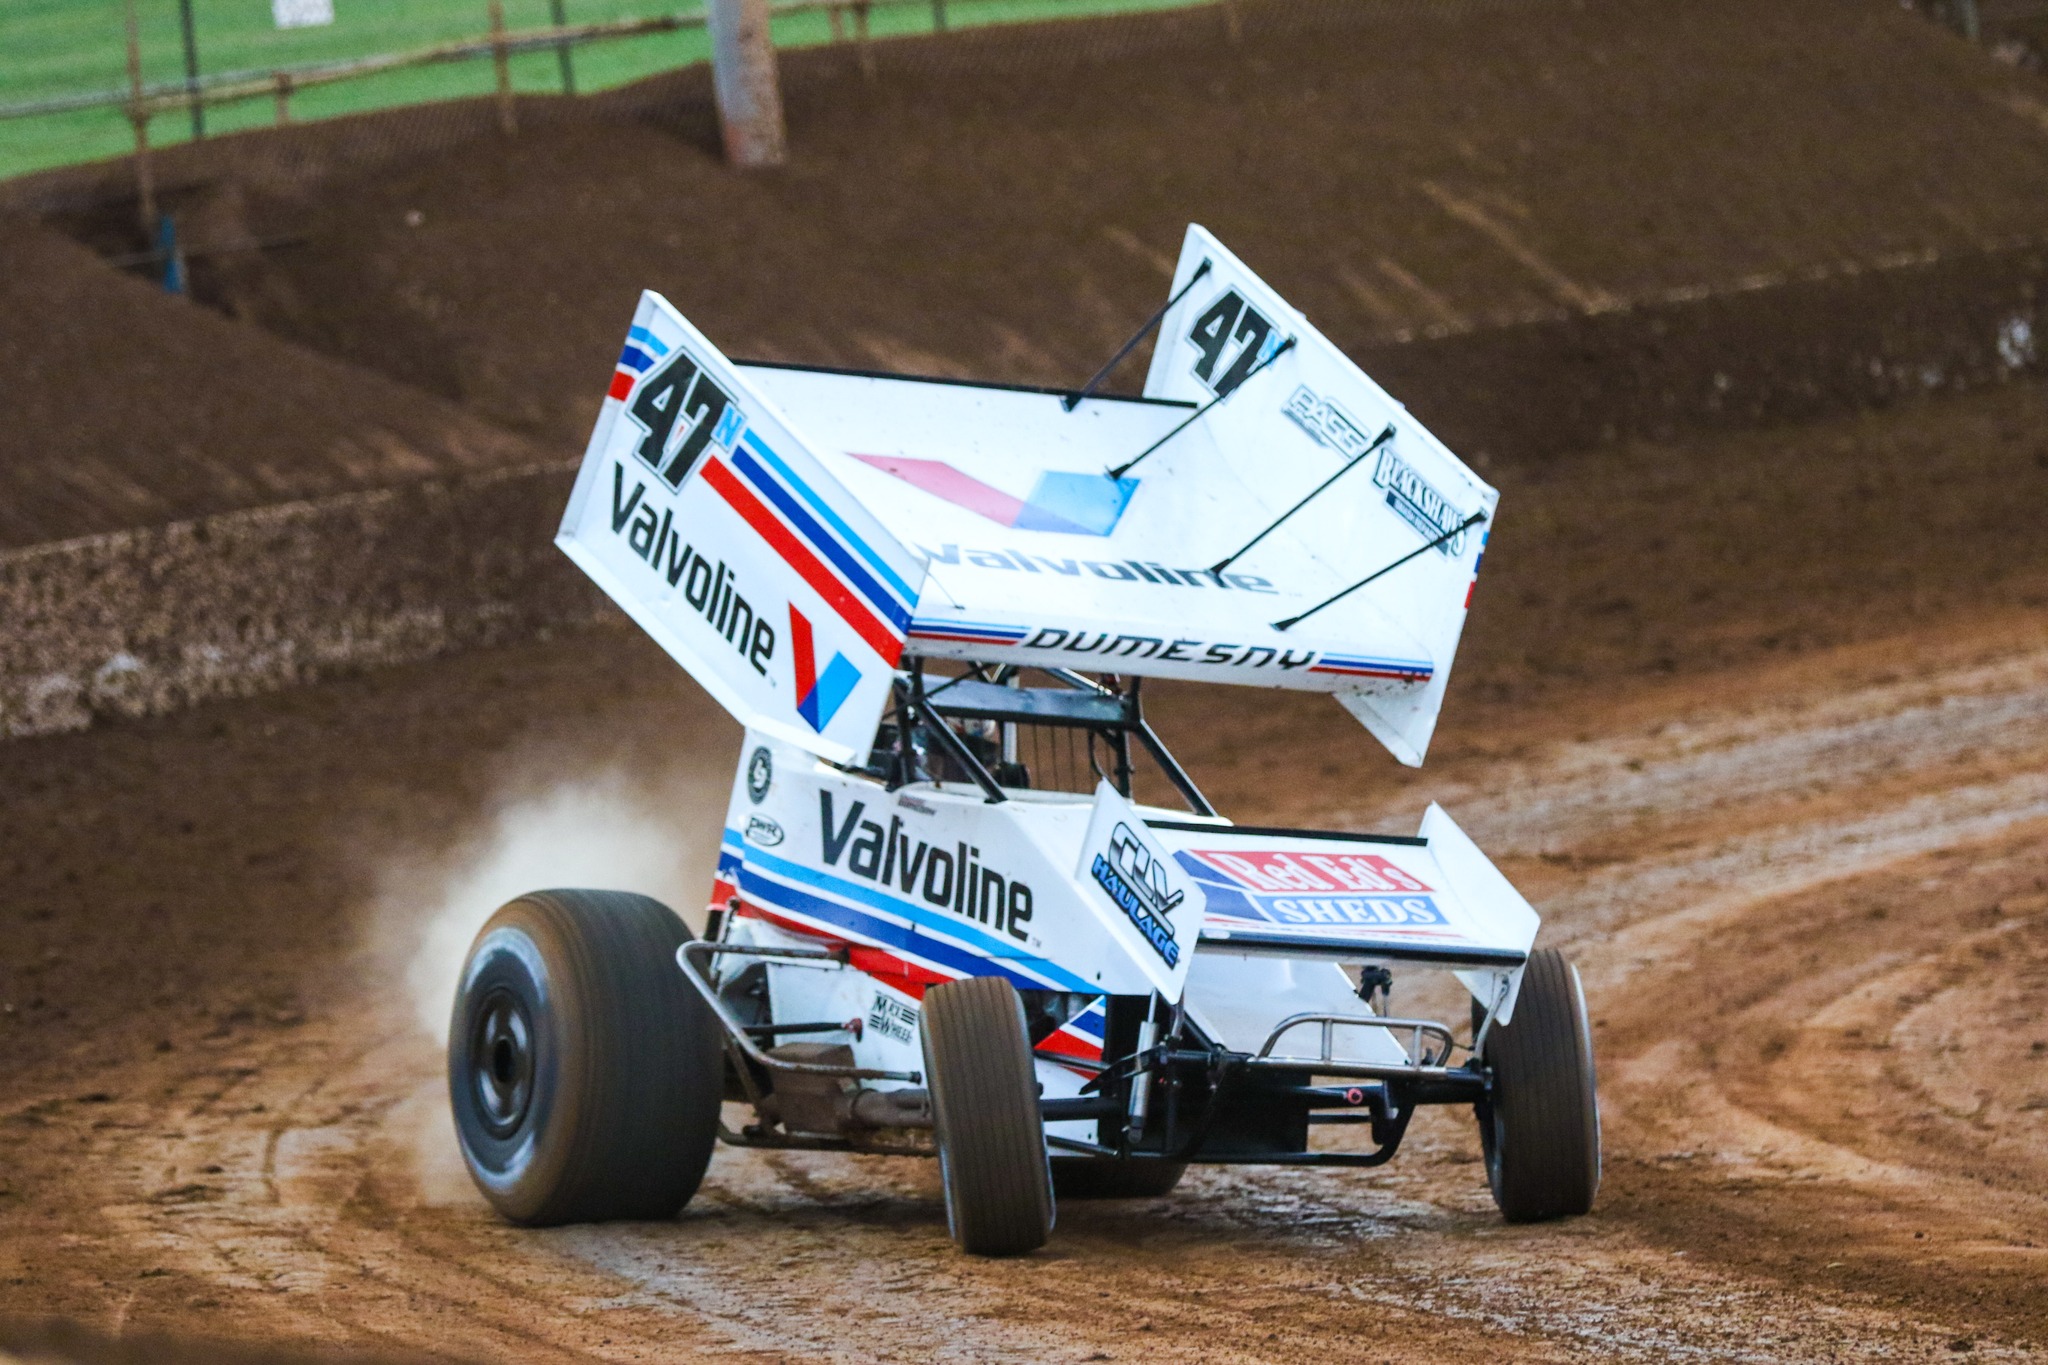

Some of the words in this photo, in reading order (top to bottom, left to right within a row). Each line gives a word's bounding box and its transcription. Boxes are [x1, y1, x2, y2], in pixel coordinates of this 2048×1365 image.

[611, 460, 775, 677] Valvoline
[911, 541, 1279, 595] Valvoline
[819, 788, 1034, 941] Valvoline
[1207, 853, 1335, 890] Red
[1091, 853, 1180, 970] HAULAGE
[1273, 898, 1437, 924] SHEDS
